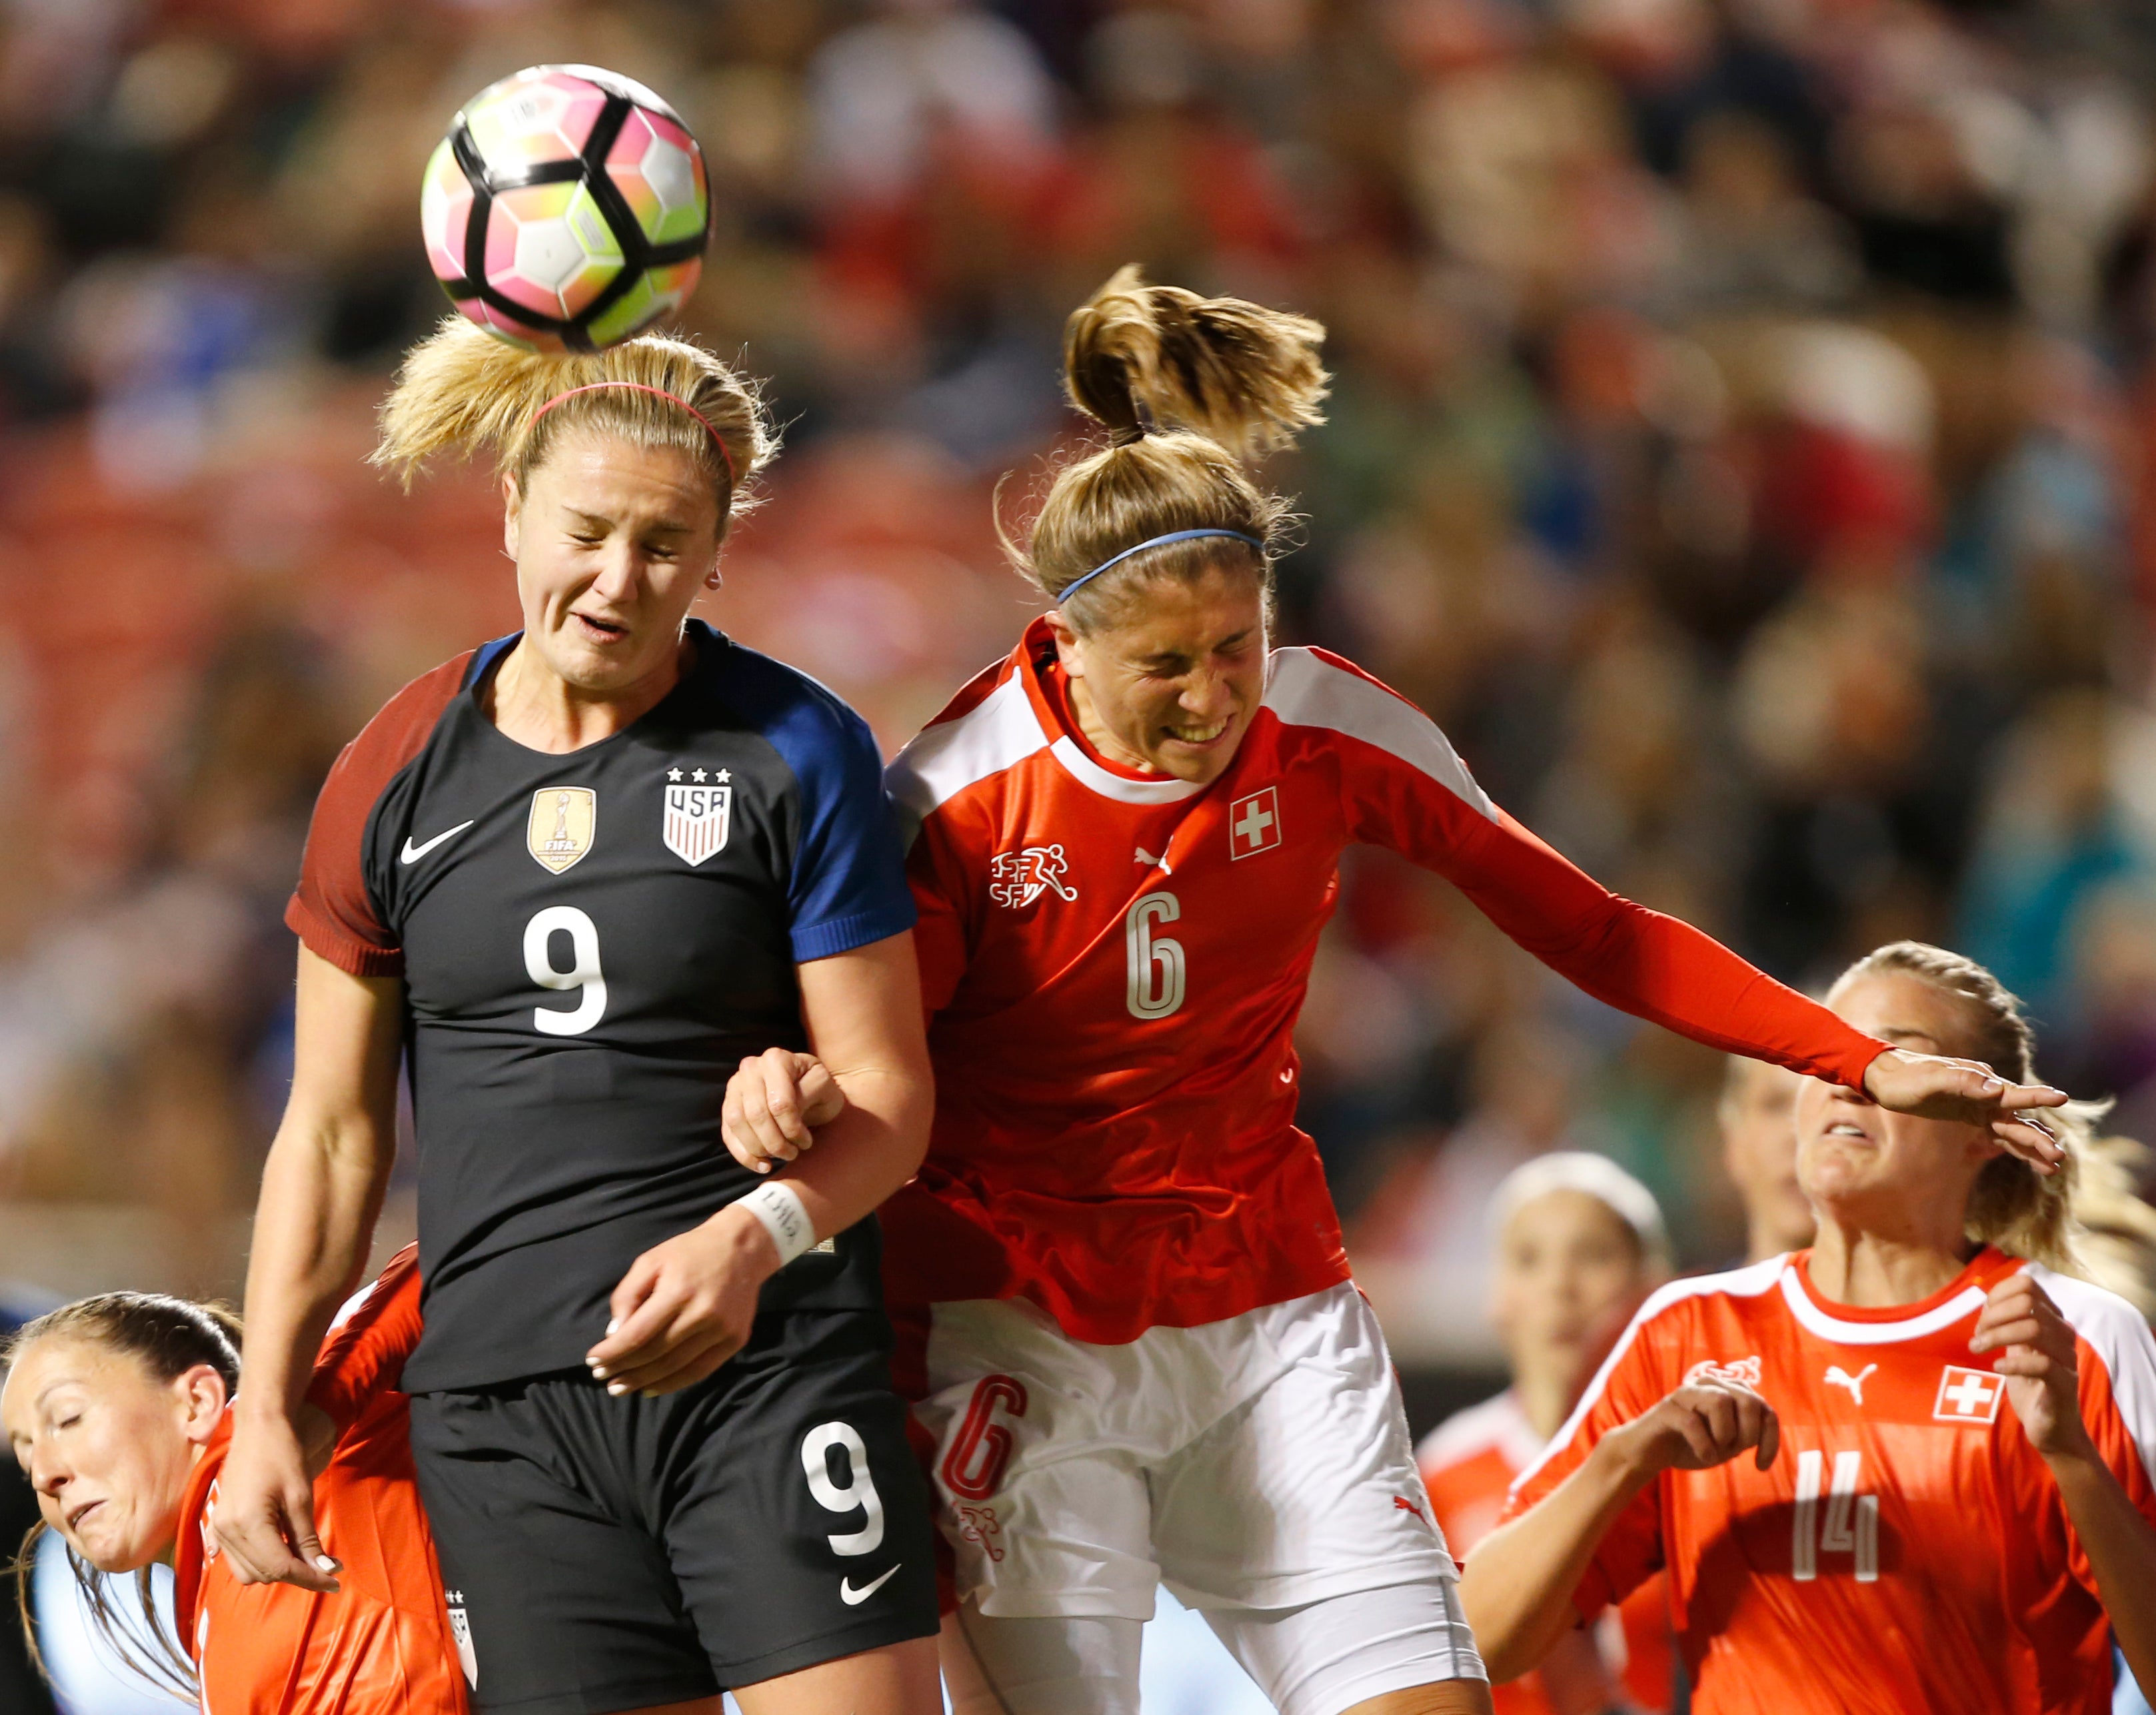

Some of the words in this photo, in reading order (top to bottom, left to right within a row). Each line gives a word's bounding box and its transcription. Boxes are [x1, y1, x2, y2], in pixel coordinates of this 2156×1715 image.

[544, 840, 574, 851] FIFA
[671, 790, 724, 818] USA
[523, 905, 608, 1037] 9
[1126, 891, 1186, 1019] 6
[800, 1421, 884, 1556] 9
[941, 1373, 1028, 1501] 6
[1792, 1449, 1879, 1583] 14
